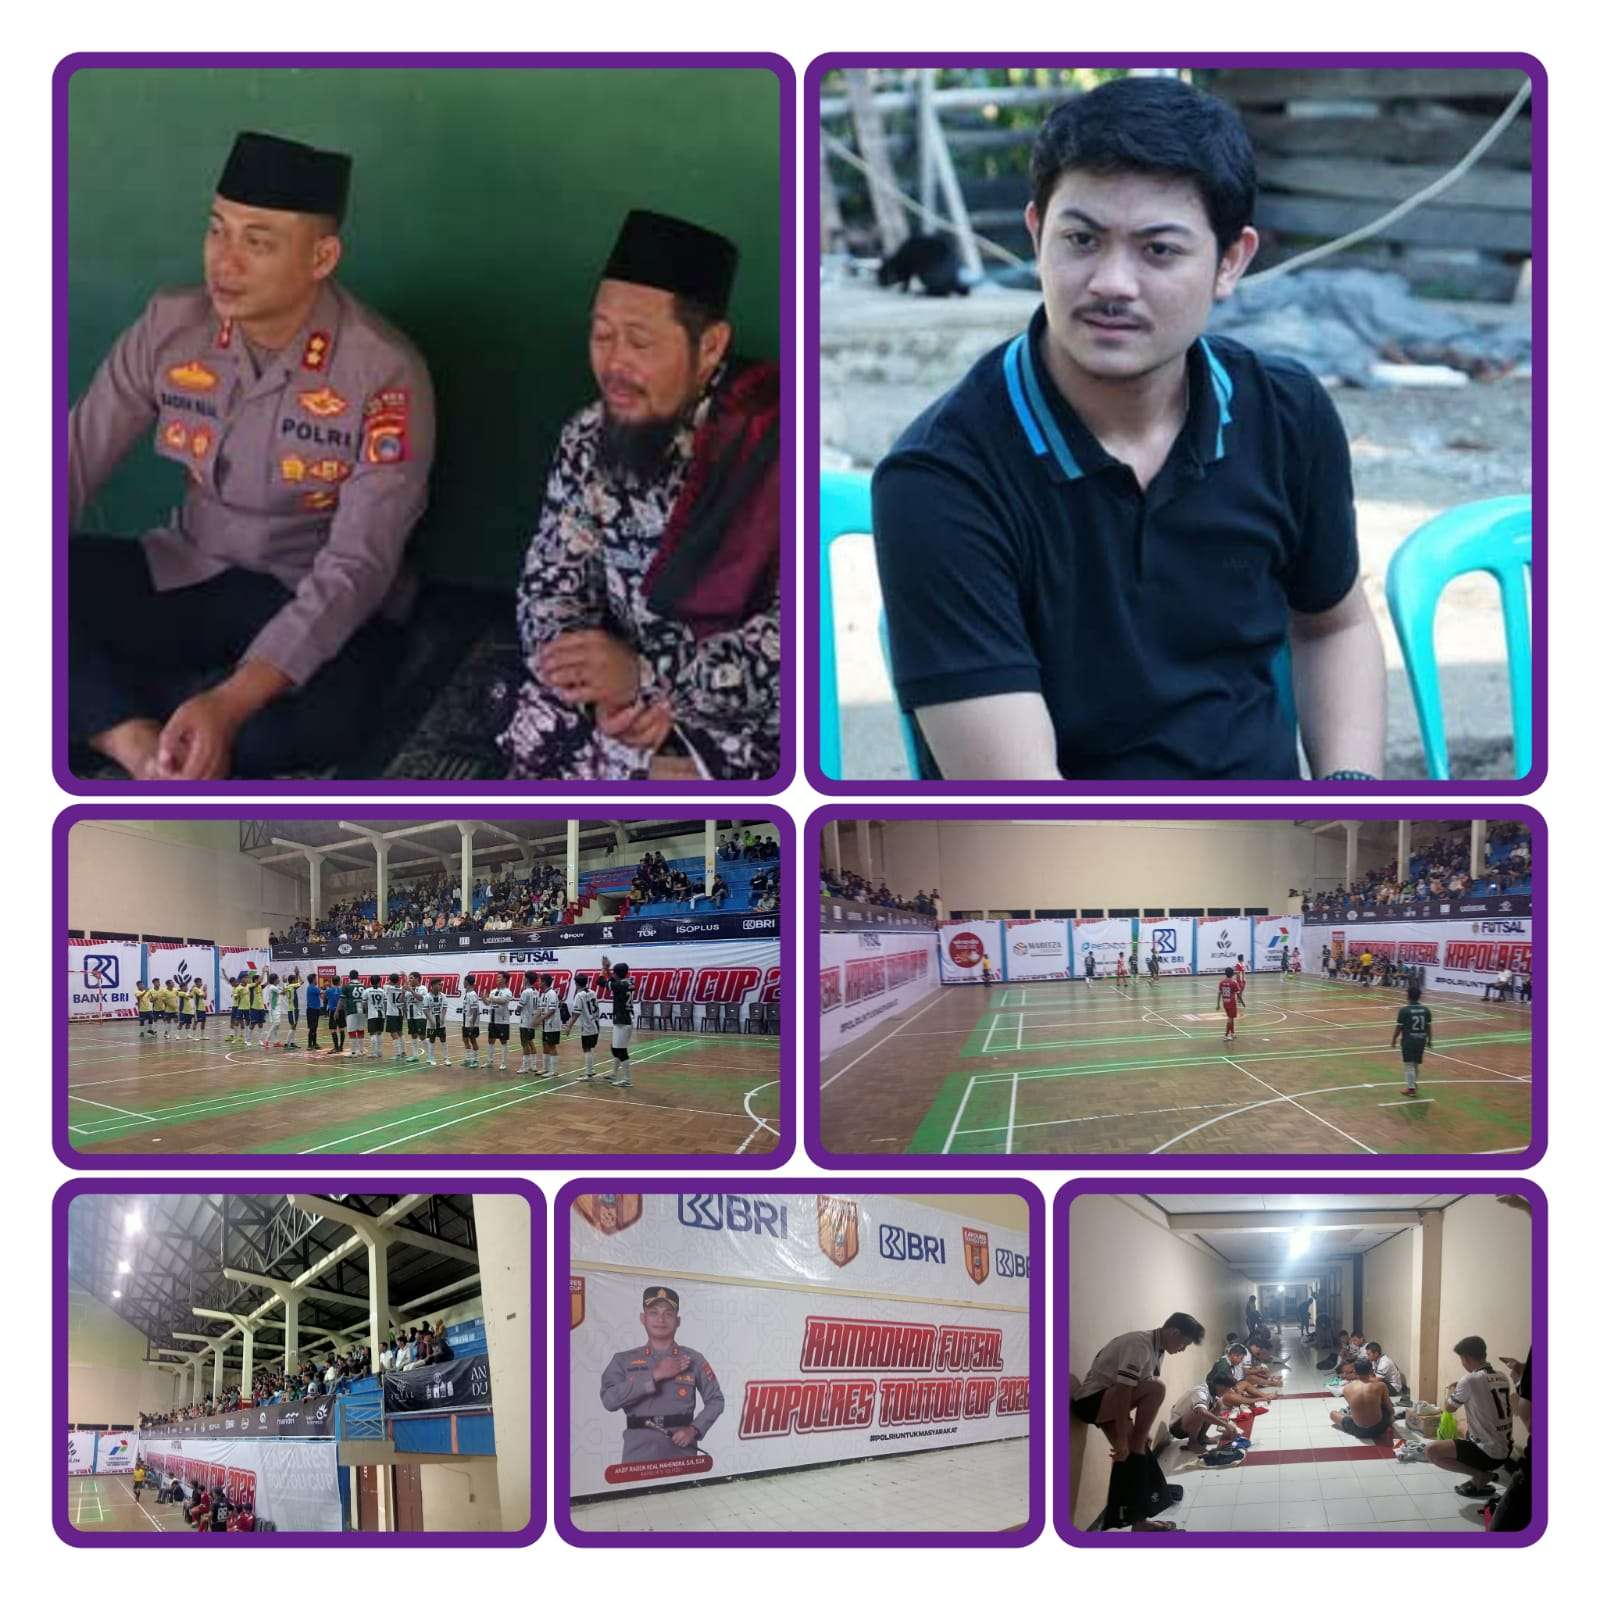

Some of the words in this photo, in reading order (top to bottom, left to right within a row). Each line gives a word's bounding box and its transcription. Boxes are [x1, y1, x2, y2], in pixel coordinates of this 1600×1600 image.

[282, 418, 351, 447] POLRI
[676, 924, 720, 934] ISOPLUS
[755, 919, 776, 929] BRI
[1481, 921, 1525, 933] FUTSAL
[509, 951, 559, 963] FUTSAL
[694, 967, 762, 1005] CUP
[73, 992, 107, 1004] BANK
[111, 992, 129, 1002] BRI
[1412, 1016, 1425, 1030] 21
[726, 1194, 788, 1239] BRI
[908, 1232, 946, 1264] BRI
[800, 1316, 937, 1372] RAMADHAN
[936, 1325, 1004, 1372] FUTSAL
[739, 1379, 876, 1440] KAPOLRES
[879, 1378, 963, 1427] TOLITOLI
[963, 1377, 996, 1420] CUP
[1491, 1387, 1511, 1420] 17
[870, 1427, 959, 1442] #POLRIUNTUKMASYARAKAT
